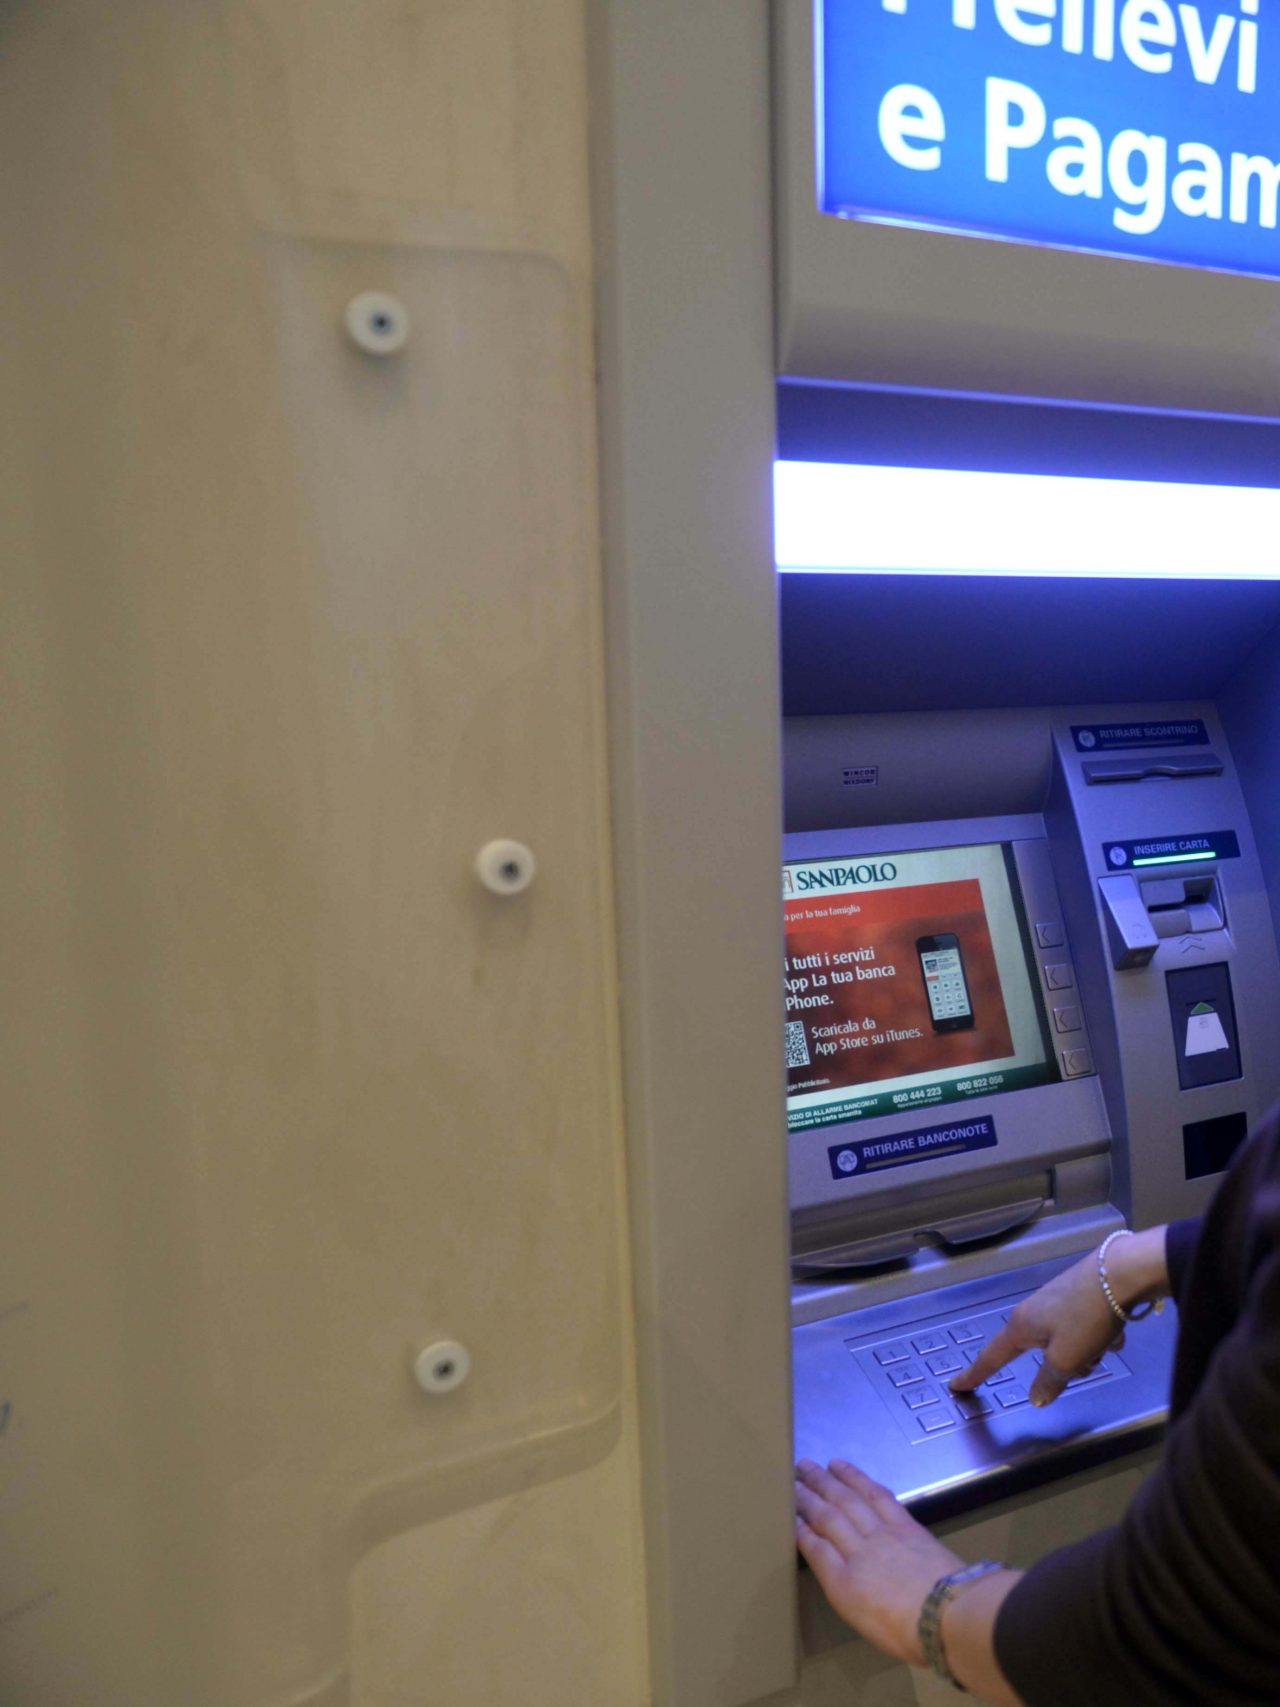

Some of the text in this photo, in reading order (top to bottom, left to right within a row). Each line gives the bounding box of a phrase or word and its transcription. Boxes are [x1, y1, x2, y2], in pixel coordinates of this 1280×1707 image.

[877, 83, 946, 170] e
[1099, 725, 1198, 739] RITIRARE SCONTRINO
[1133, 839, 1210, 855] INSERIRE CARTA
[796, 862, 897, 890] SANPAOLO
[790, 912, 803, 922] per
[805, 909, 814, 919] la
[815, 908, 828, 917] tua
[829, 904, 861, 917] famiglia
[792, 953, 822, 970] tutti
[825, 952, 830, 966] i
[833, 946, 875, 965] servizi
[784, 965, 896, 993] App La tua banca
[811, 1017, 876, 1038] Scaricala da
[815, 1027, 924, 1056] App Store su iTunes.
[892, 1093, 909, 1103] 800
[909, 1090, 926, 1100] 444
[926, 1086, 942, 1097] 223
[956, 1080, 972, 1091] 800
[813, 1105, 843, 1117] ALLARME
[844, 1099, 878, 1111] BANCOMAT
[862, 1123, 988, 1158] RITIRARE BANCONOTE
